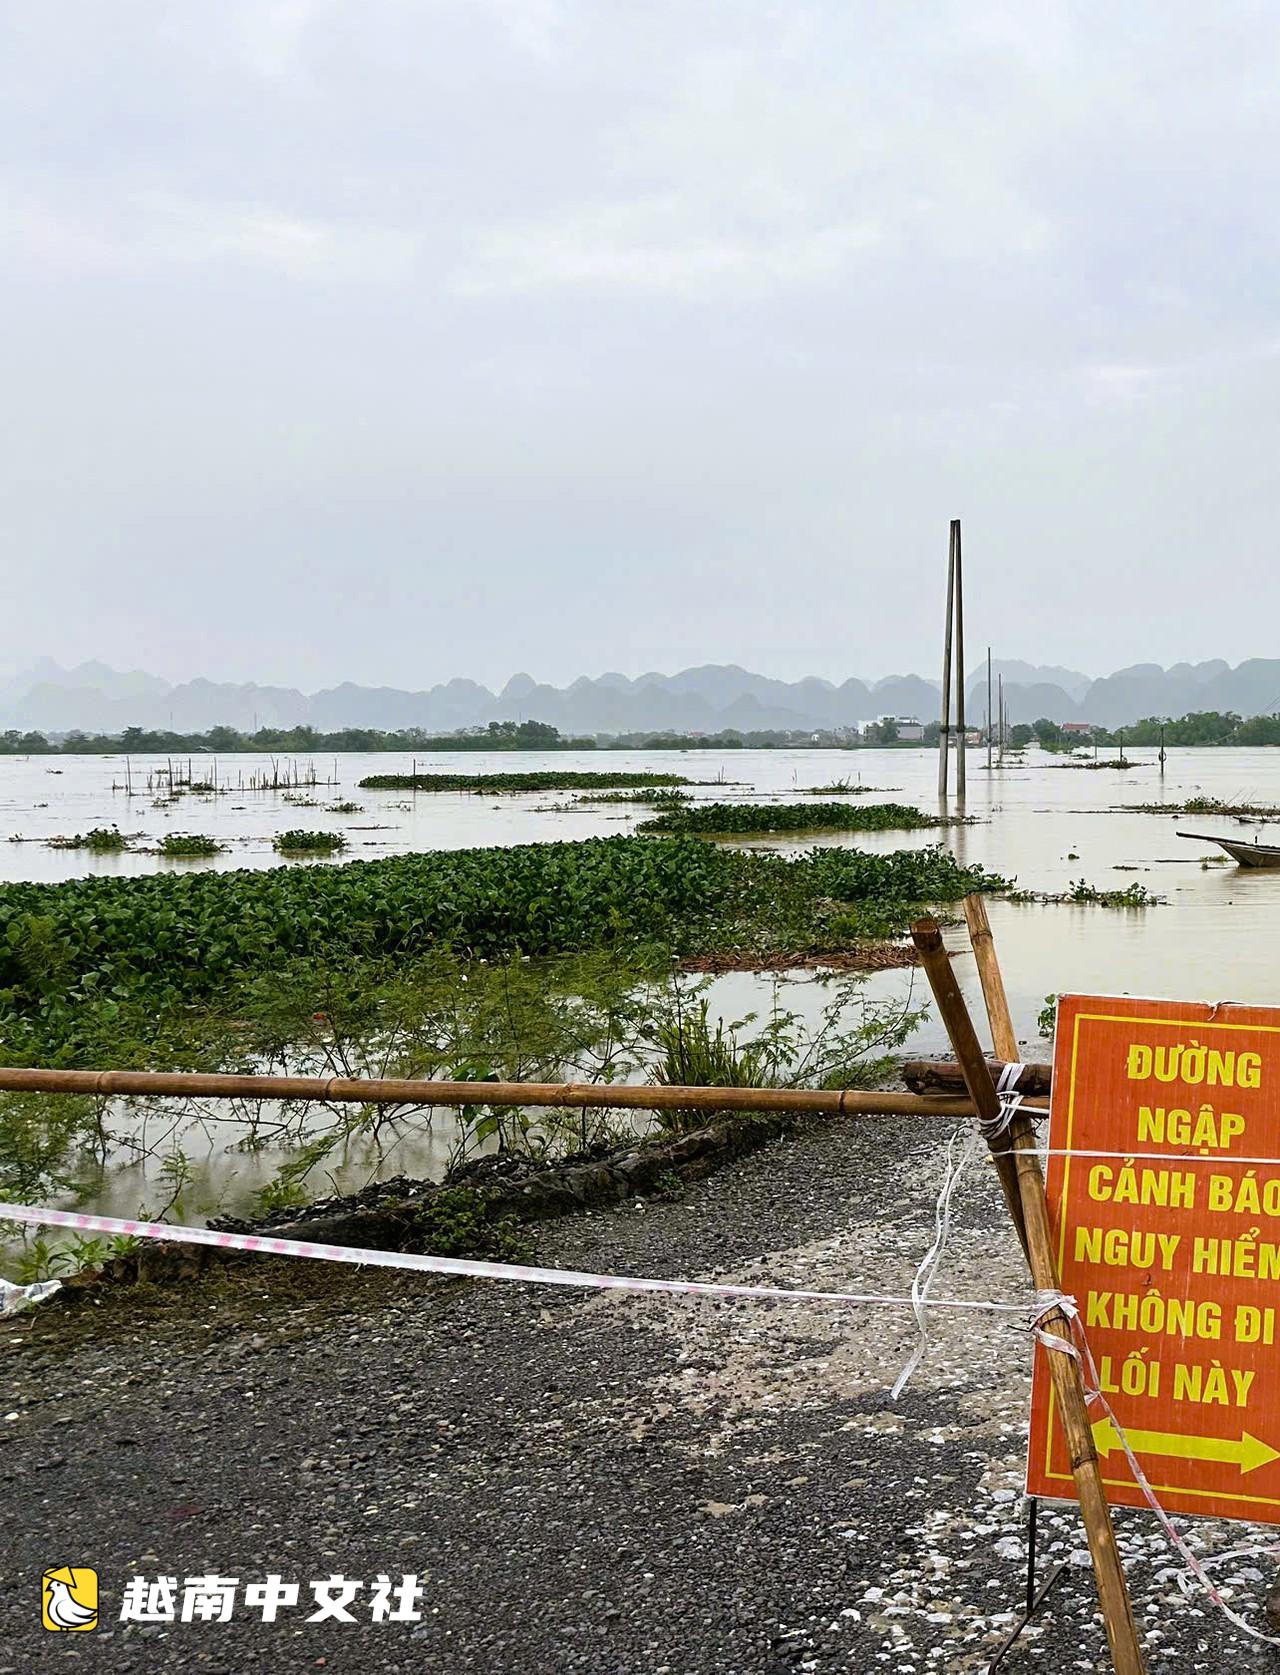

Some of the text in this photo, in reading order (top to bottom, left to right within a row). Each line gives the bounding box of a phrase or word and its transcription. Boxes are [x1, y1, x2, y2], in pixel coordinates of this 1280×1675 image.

[1127, 1040, 1262, 1089] ĐƯỜNG
[1137, 1104, 1246, 1156] NGẬP
[1088, 1157, 1196, 1209] CẢNH
[1074, 1226, 1181, 1271] NGUY
[1086, 1288, 1275, 1345] KHÔNG ĐI
[1098, 1346, 1256, 1408] LỐI NÀY
